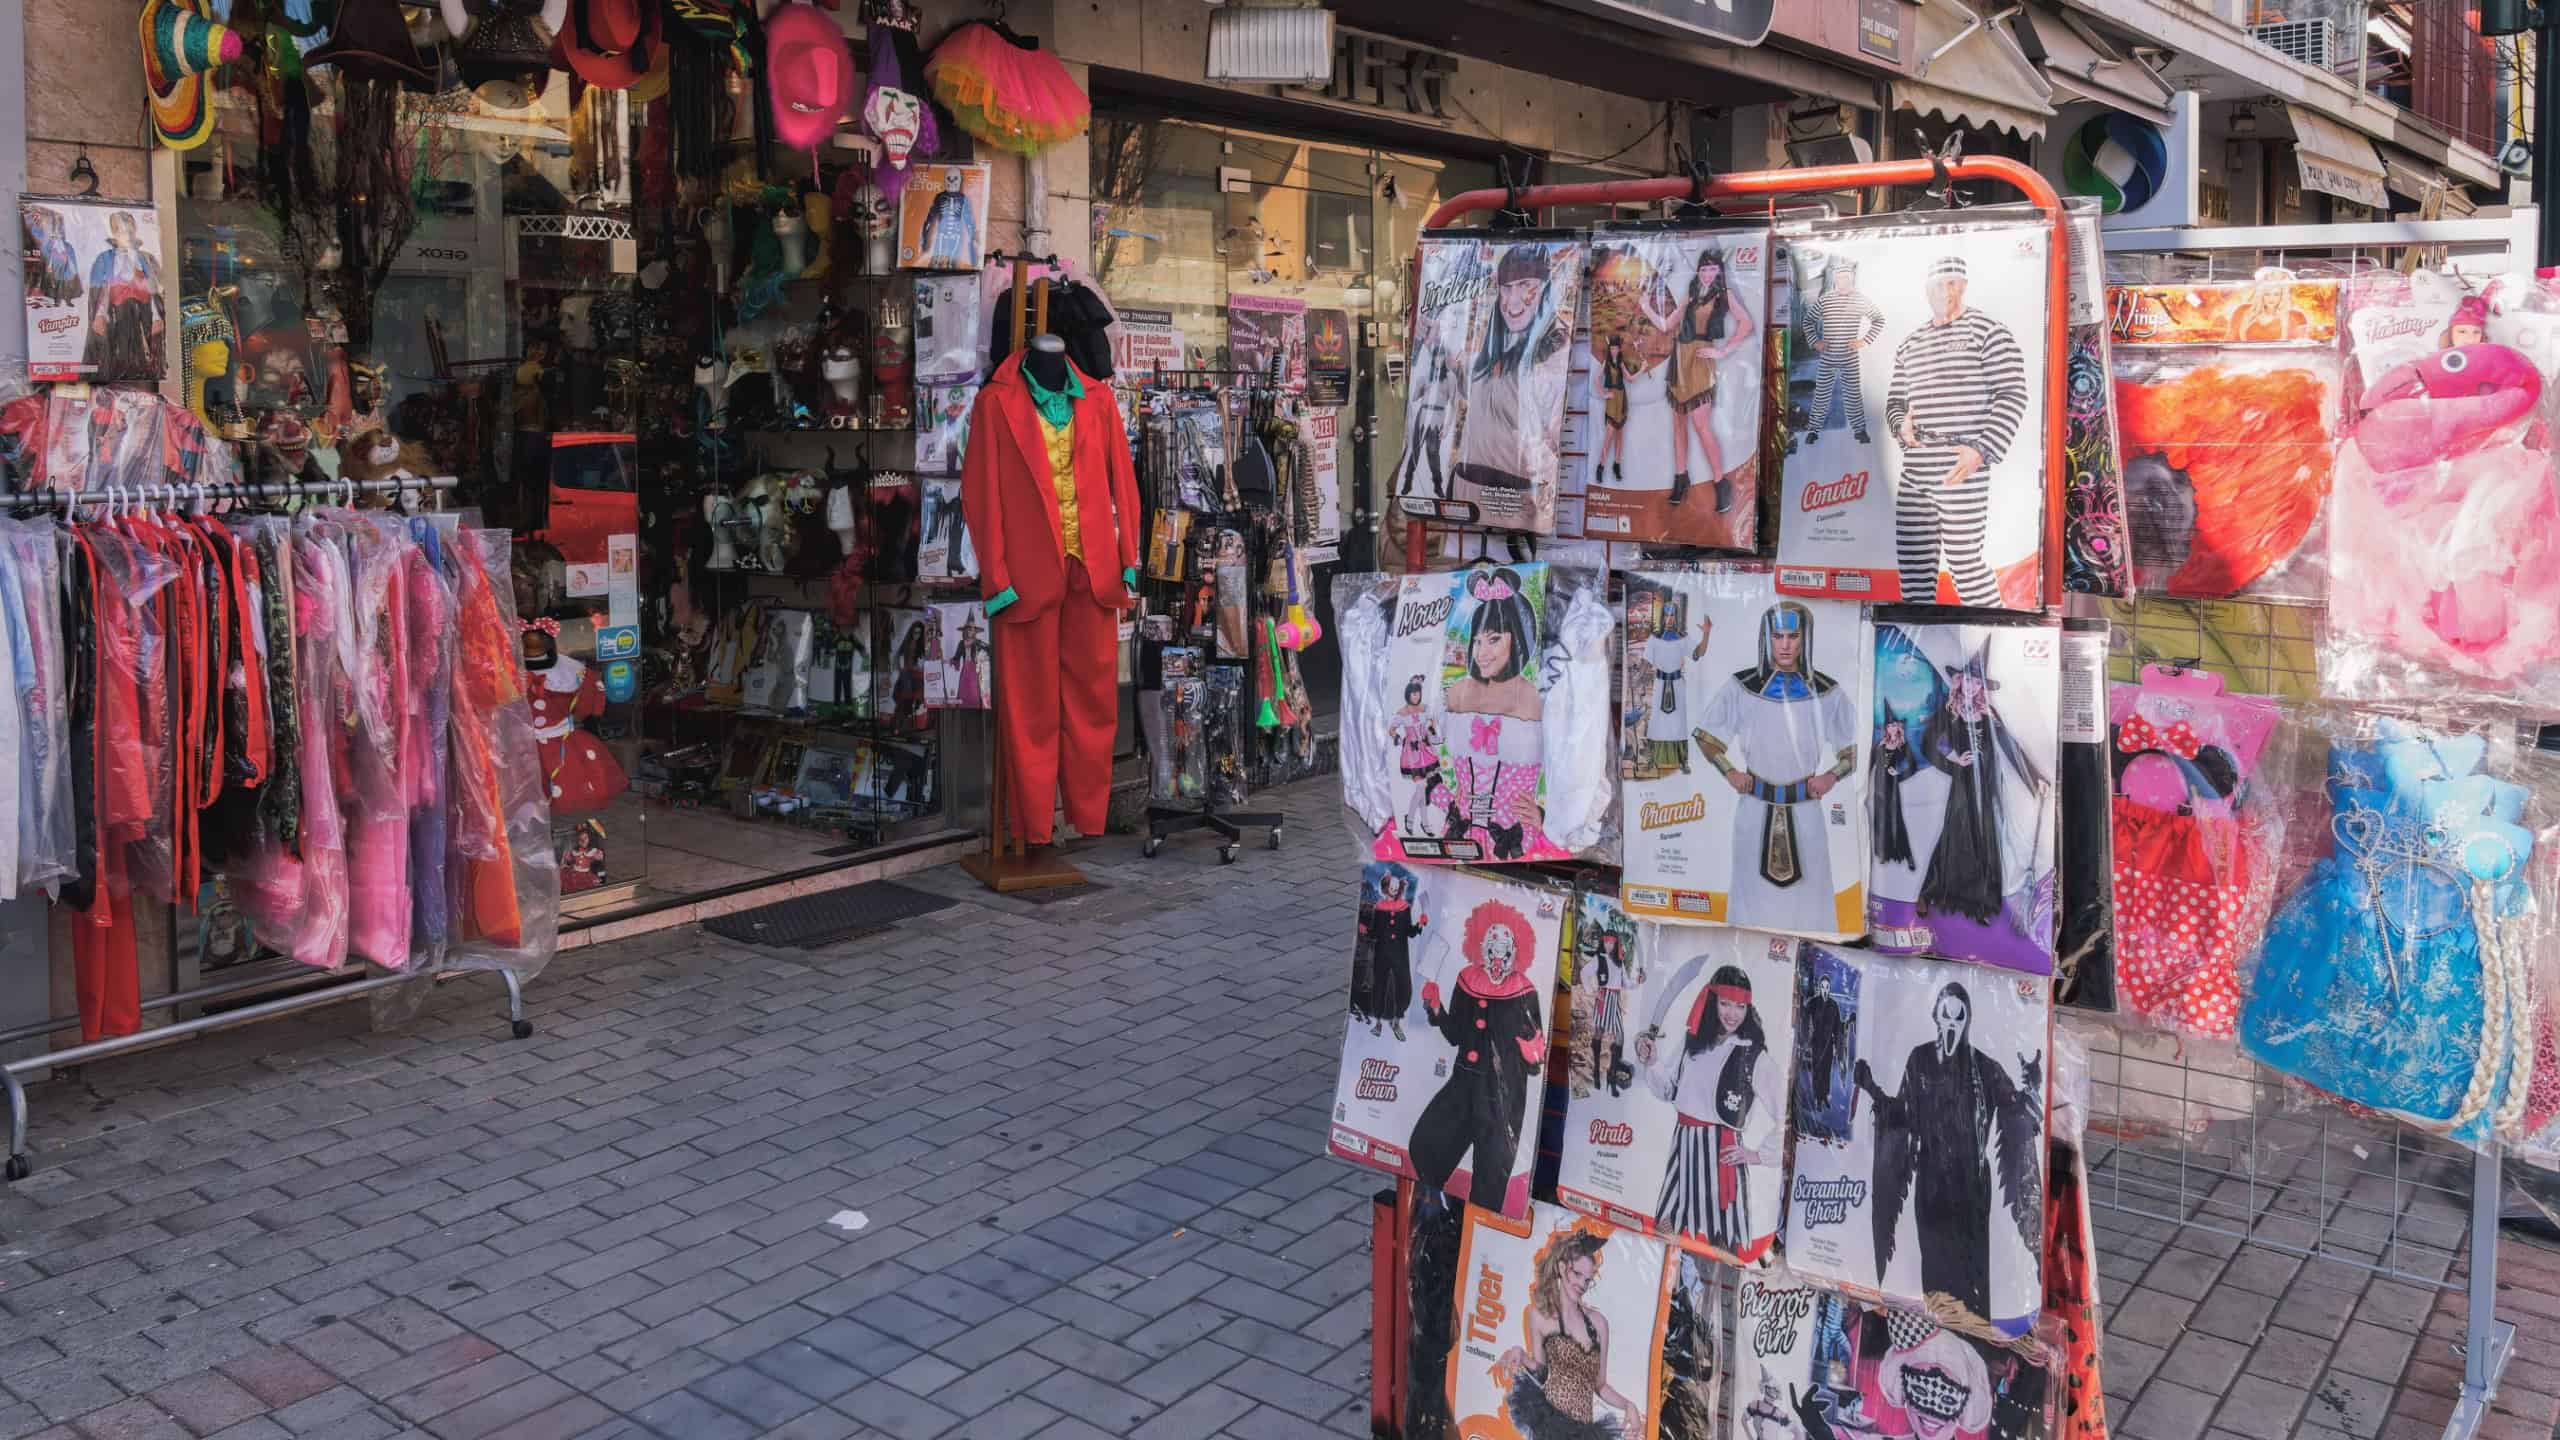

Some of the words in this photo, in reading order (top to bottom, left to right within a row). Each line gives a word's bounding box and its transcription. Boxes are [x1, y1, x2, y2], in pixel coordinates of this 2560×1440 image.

[38, 315, 80, 334] Vampire
[1801, 470, 1869, 512] Convict
[1397, 595, 1454, 638] Mouse
[1640, 793, 1705, 831] Pharaoh
[1361, 1058, 1400, 1081] Killer
[1356, 1079, 1397, 1102] Clown
[1589, 1118, 1632, 1146] Pirate
[1794, 1174, 1866, 1208] Screaming
[1805, 1199, 1846, 1230] Ghost
[1466, 1263, 1505, 1343] Tiger
[1740, 1281, 1817, 1318] Pierrot
[1754, 1315, 1797, 1358] Girl
